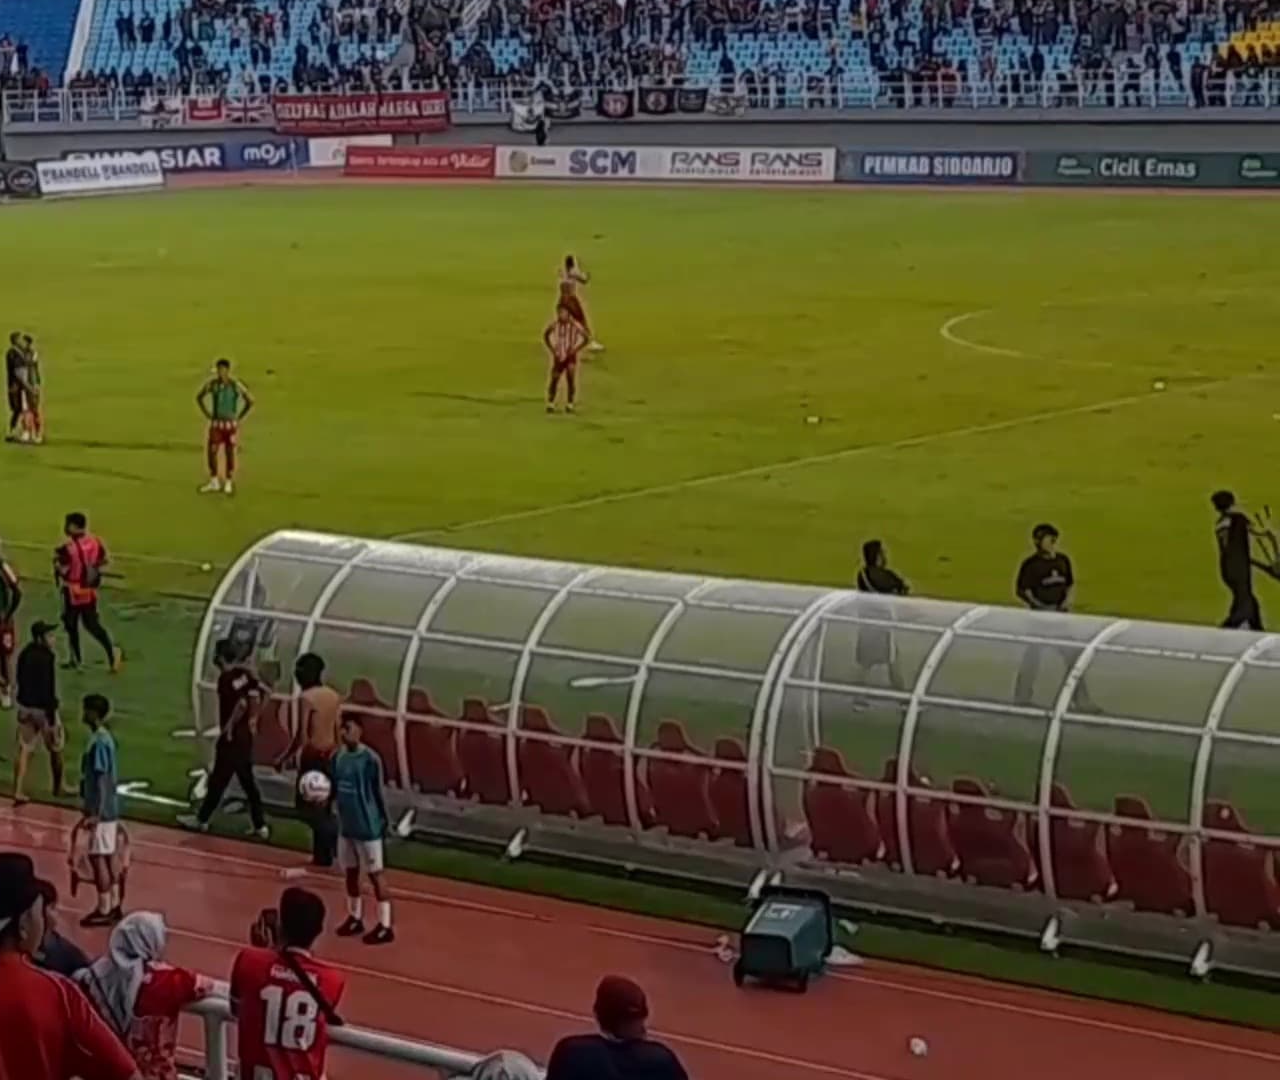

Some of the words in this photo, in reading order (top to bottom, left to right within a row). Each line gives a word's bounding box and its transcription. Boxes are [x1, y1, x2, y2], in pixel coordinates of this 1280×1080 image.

[569, 149, 637, 175] SCM
[671, 151, 741, 168] RANS
[750, 151, 823, 168] RANS
[863, 155, 929, 175] PEMKAB
[933, 156, 1013, 176] SIDOARJO
[1100, 157, 1140, 177] Cicil
[1145, 158, 1197, 177] Emas
[260, 985, 318, 1051] 18
